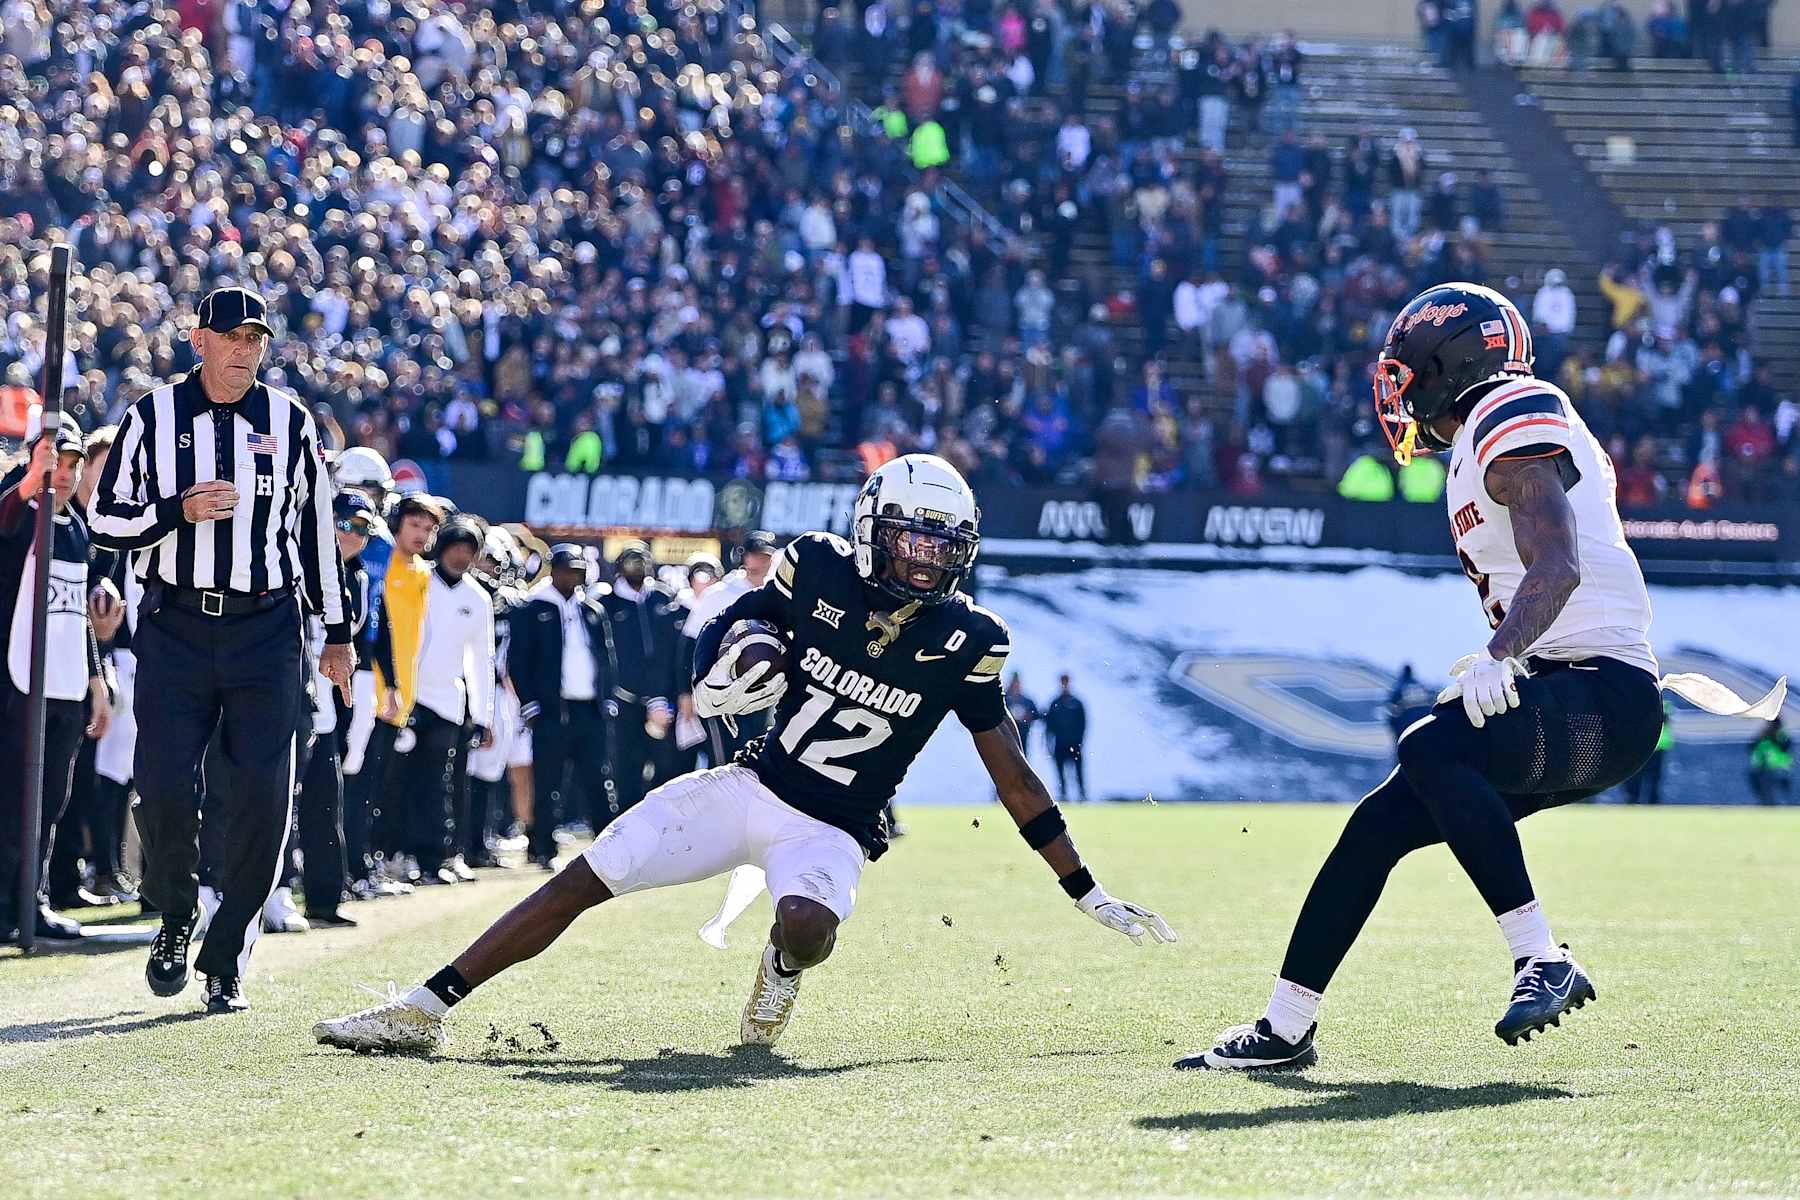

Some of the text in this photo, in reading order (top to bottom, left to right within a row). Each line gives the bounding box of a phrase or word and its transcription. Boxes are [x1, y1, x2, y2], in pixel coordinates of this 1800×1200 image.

[179, 433, 191, 449] S
[256, 474, 273, 496] H
[761, 482, 860, 535] BUFF
[925, 509, 946, 522] BUFFS
[1038, 501, 1154, 540] ARRW
[1454, 499, 1485, 538] STATE
[944, 629, 967, 652] D
[800, 647, 923, 718] COLORADO
[779, 684, 894, 786] 12
